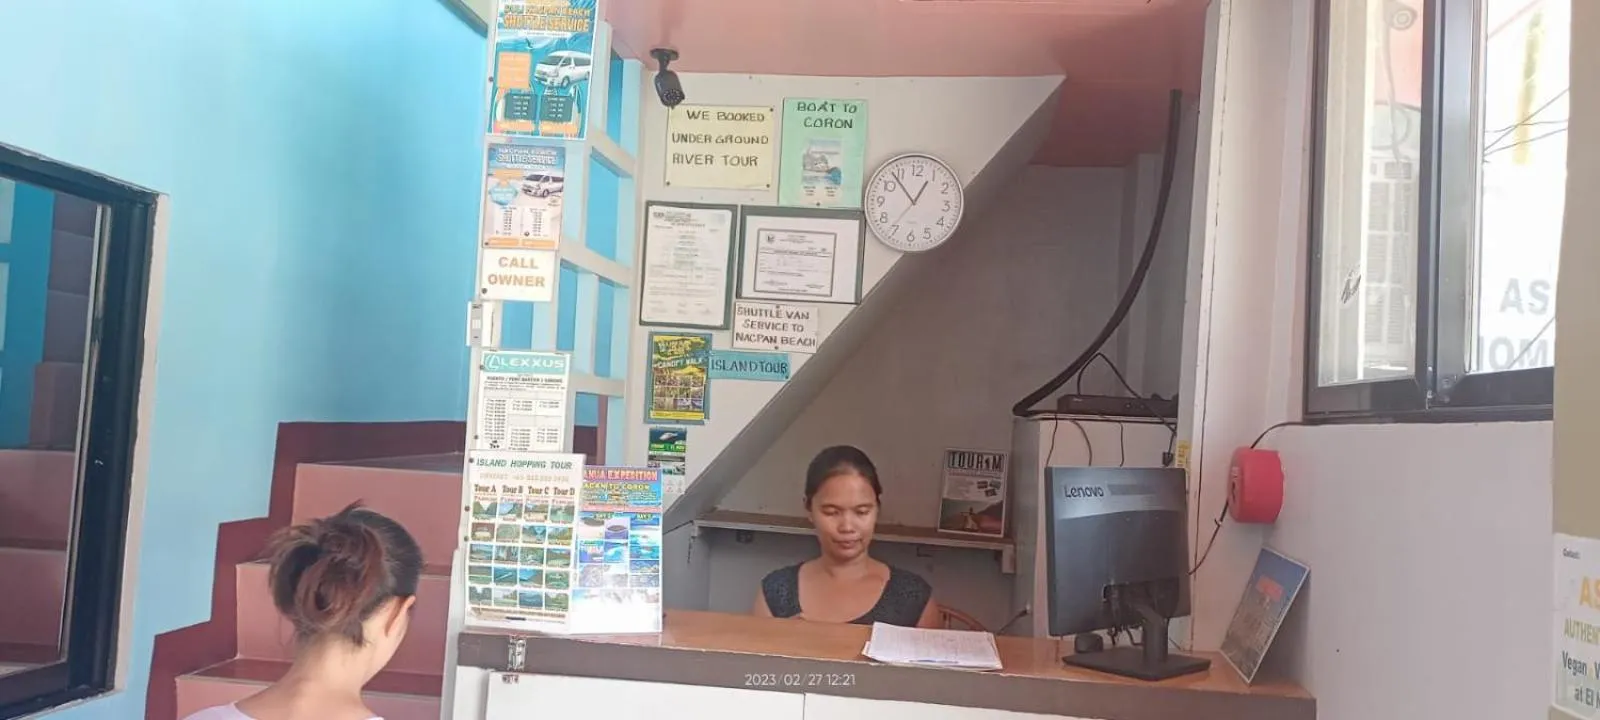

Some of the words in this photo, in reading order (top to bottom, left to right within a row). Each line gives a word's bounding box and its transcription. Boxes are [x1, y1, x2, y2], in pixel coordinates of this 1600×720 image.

[504, 15, 546, 30] SHUTTLE
[547, 17, 589, 32] SERVICE
[797, 101, 836, 113] BOAT
[843, 103, 857, 114] TO
[686, 110, 710, 120] WE
[717, 112, 765, 122] BOOKED
[804, 119, 854, 129] CORON
[672, 154, 713, 165] RIVER
[723, 155, 758, 167] TOUR
[897, 167, 905, 181] 11
[912, 165, 924, 177] 12
[884, 180, 896, 192] 10
[941, 182, 949, 195] 2
[877, 195, 885, 208] 9
[942, 200, 951, 213] 3
[879, 212, 888, 224] 8
[936, 216, 945, 228] 4
[891, 224, 900, 237] 7
[906, 230, 915, 243] 6
[922, 227, 931, 240] 5
[498, 256, 540, 269] CALL
[487, 274, 546, 287] OWNER
[737, 306, 782, 319] SHUTTLE
[786, 311, 810, 321] VAN
[742, 319, 788, 332] SERVICE
[792, 324, 805, 333] TO
[736, 333, 777, 344] NACPAN
[780, 337, 816, 347] BEACH
[760, 361, 789, 374] TOUR
[476, 459, 507, 468] ISLAND
[511, 461, 547, 469] HOPPING
[551, 462, 572, 470] TOUR
[608, 469, 658, 482] EXPEDITION
[474, 484, 490, 493] Tour
[491, 485, 497, 493] A
[502, 485, 518, 494] Tour
[528, 486, 544, 495] Tour
[545, 486, 550, 495] C
[553, 487, 569, 496] Tour
[1064, 485, 1105, 499] Lenovo
[1562, 650, 1587, 677] Vegan
[1574, 687, 1583, 703] at
[1585, 687, 1594, 707] El
